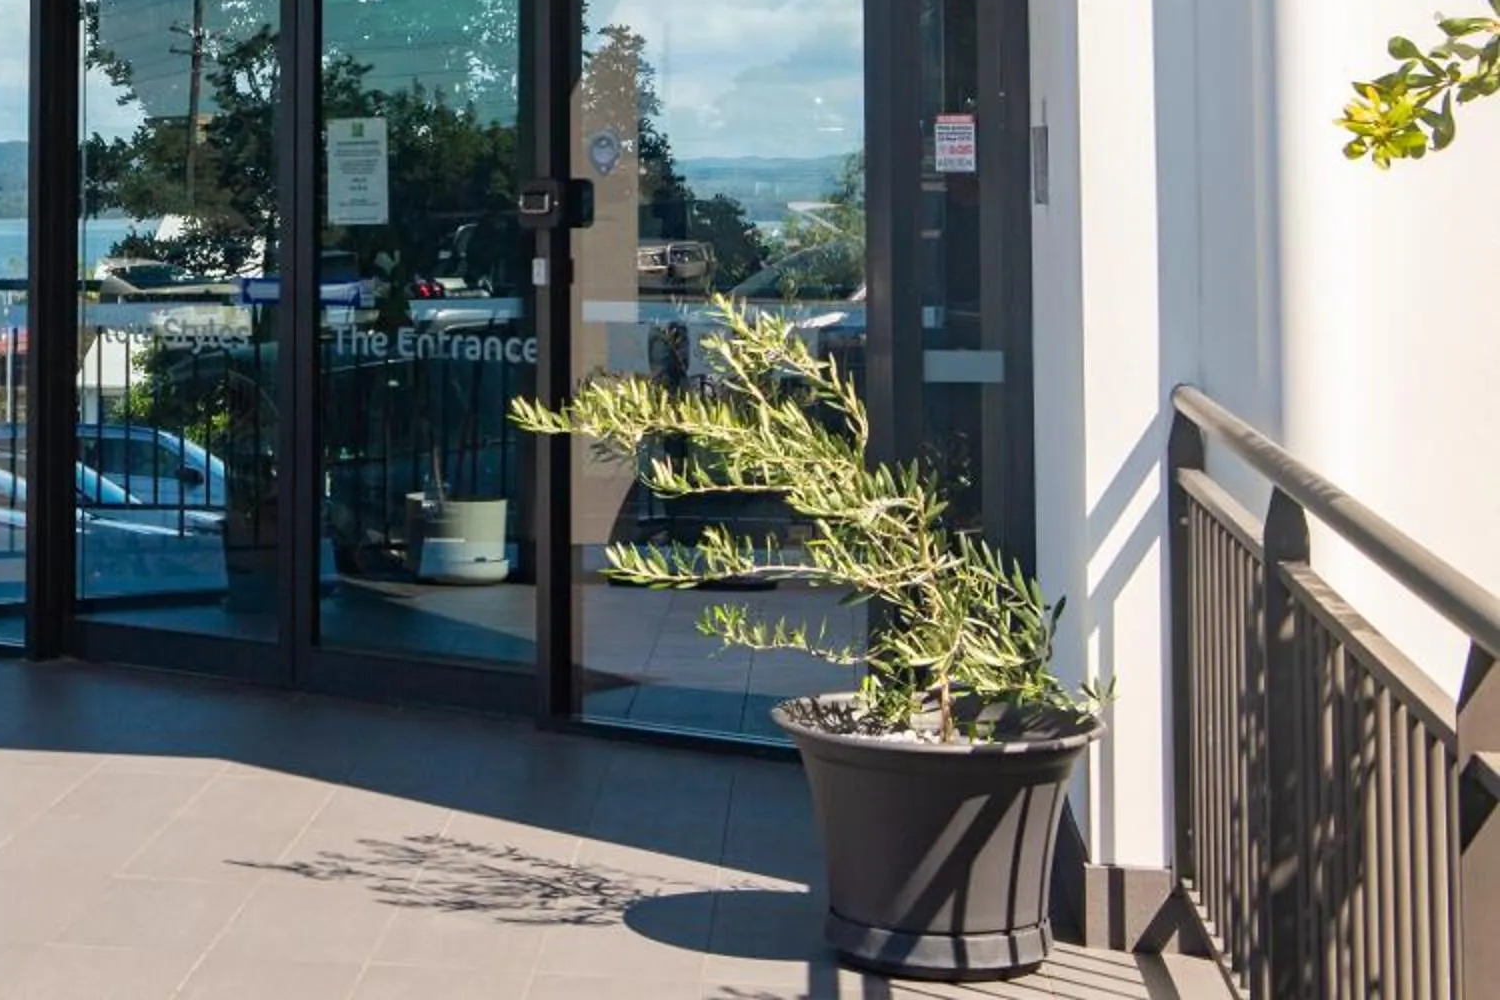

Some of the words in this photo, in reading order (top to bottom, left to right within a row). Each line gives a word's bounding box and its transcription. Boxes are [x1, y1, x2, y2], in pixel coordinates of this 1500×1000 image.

[162, 317, 252, 356] Styles
[331, 324, 389, 358] The
[397, 327, 538, 364] Entrance
